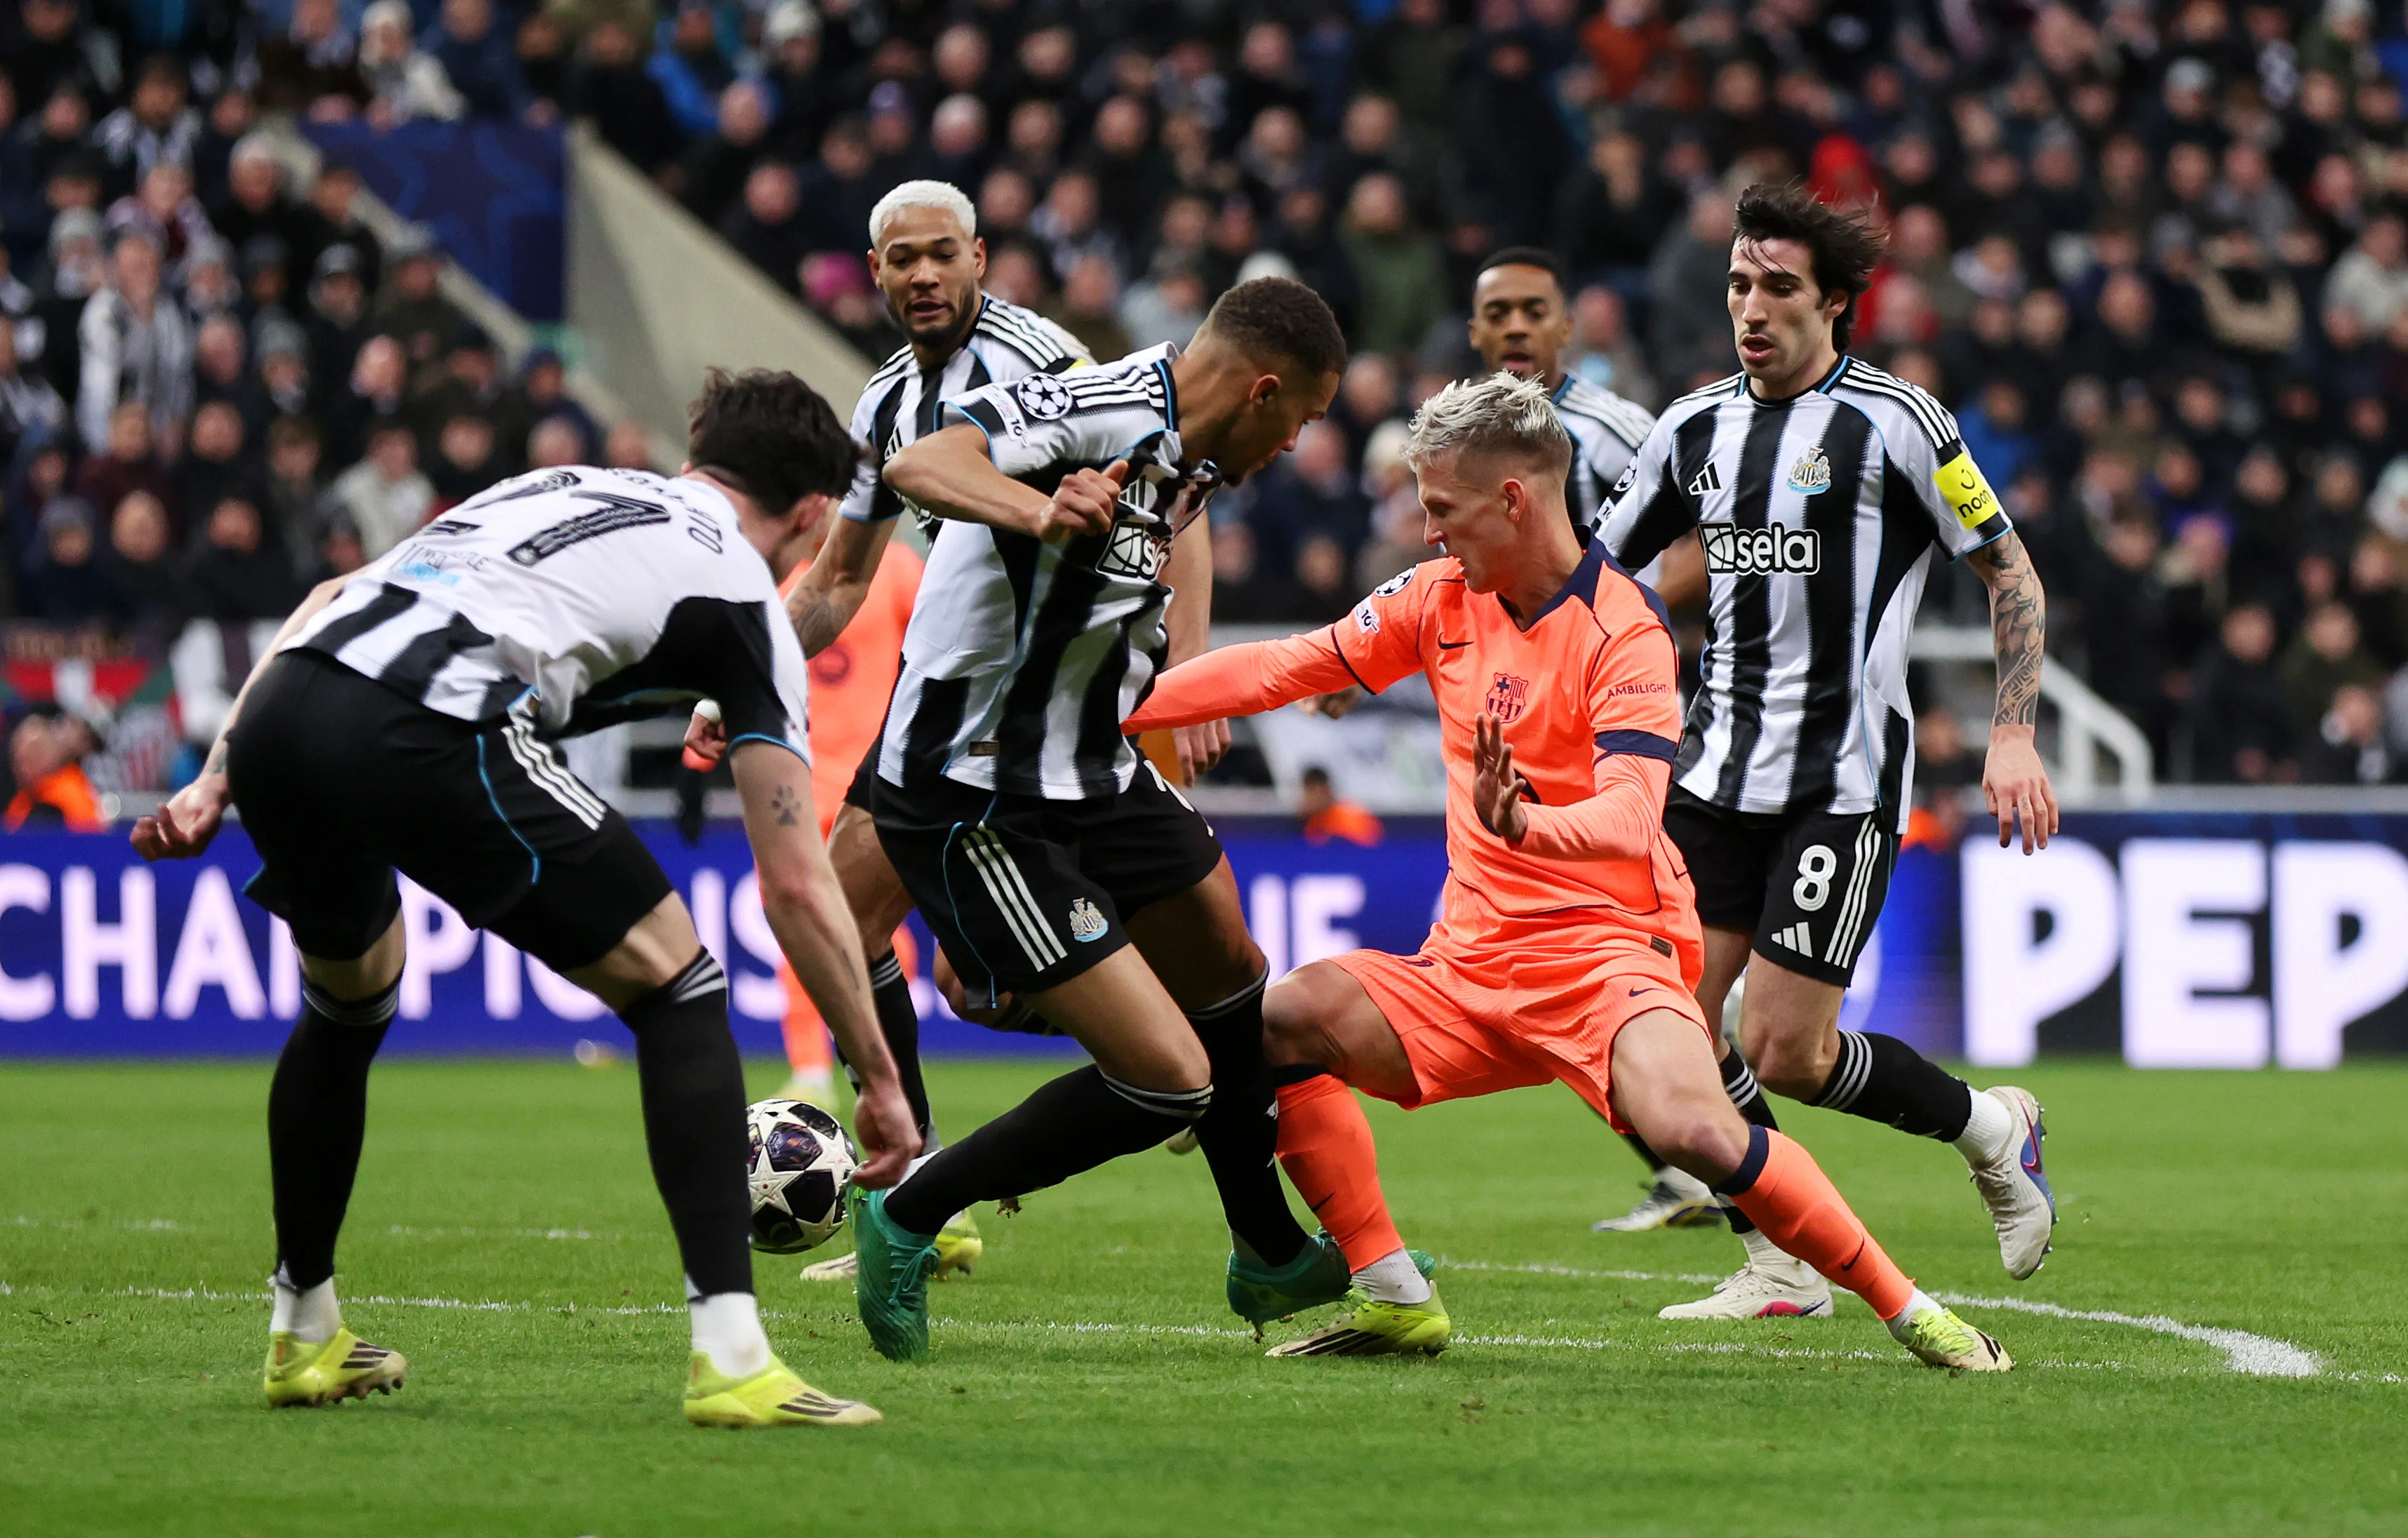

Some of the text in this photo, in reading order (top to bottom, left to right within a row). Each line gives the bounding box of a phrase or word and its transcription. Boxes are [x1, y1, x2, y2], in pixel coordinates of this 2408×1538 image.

[1958, 490, 1992, 519] noon
[1736, 526, 1814, 569] sela
[1607, 683, 1667, 700] AMBILIGHT
[1793, 845, 1837, 911] 8
[1961, 838, 2408, 1069] PEP
